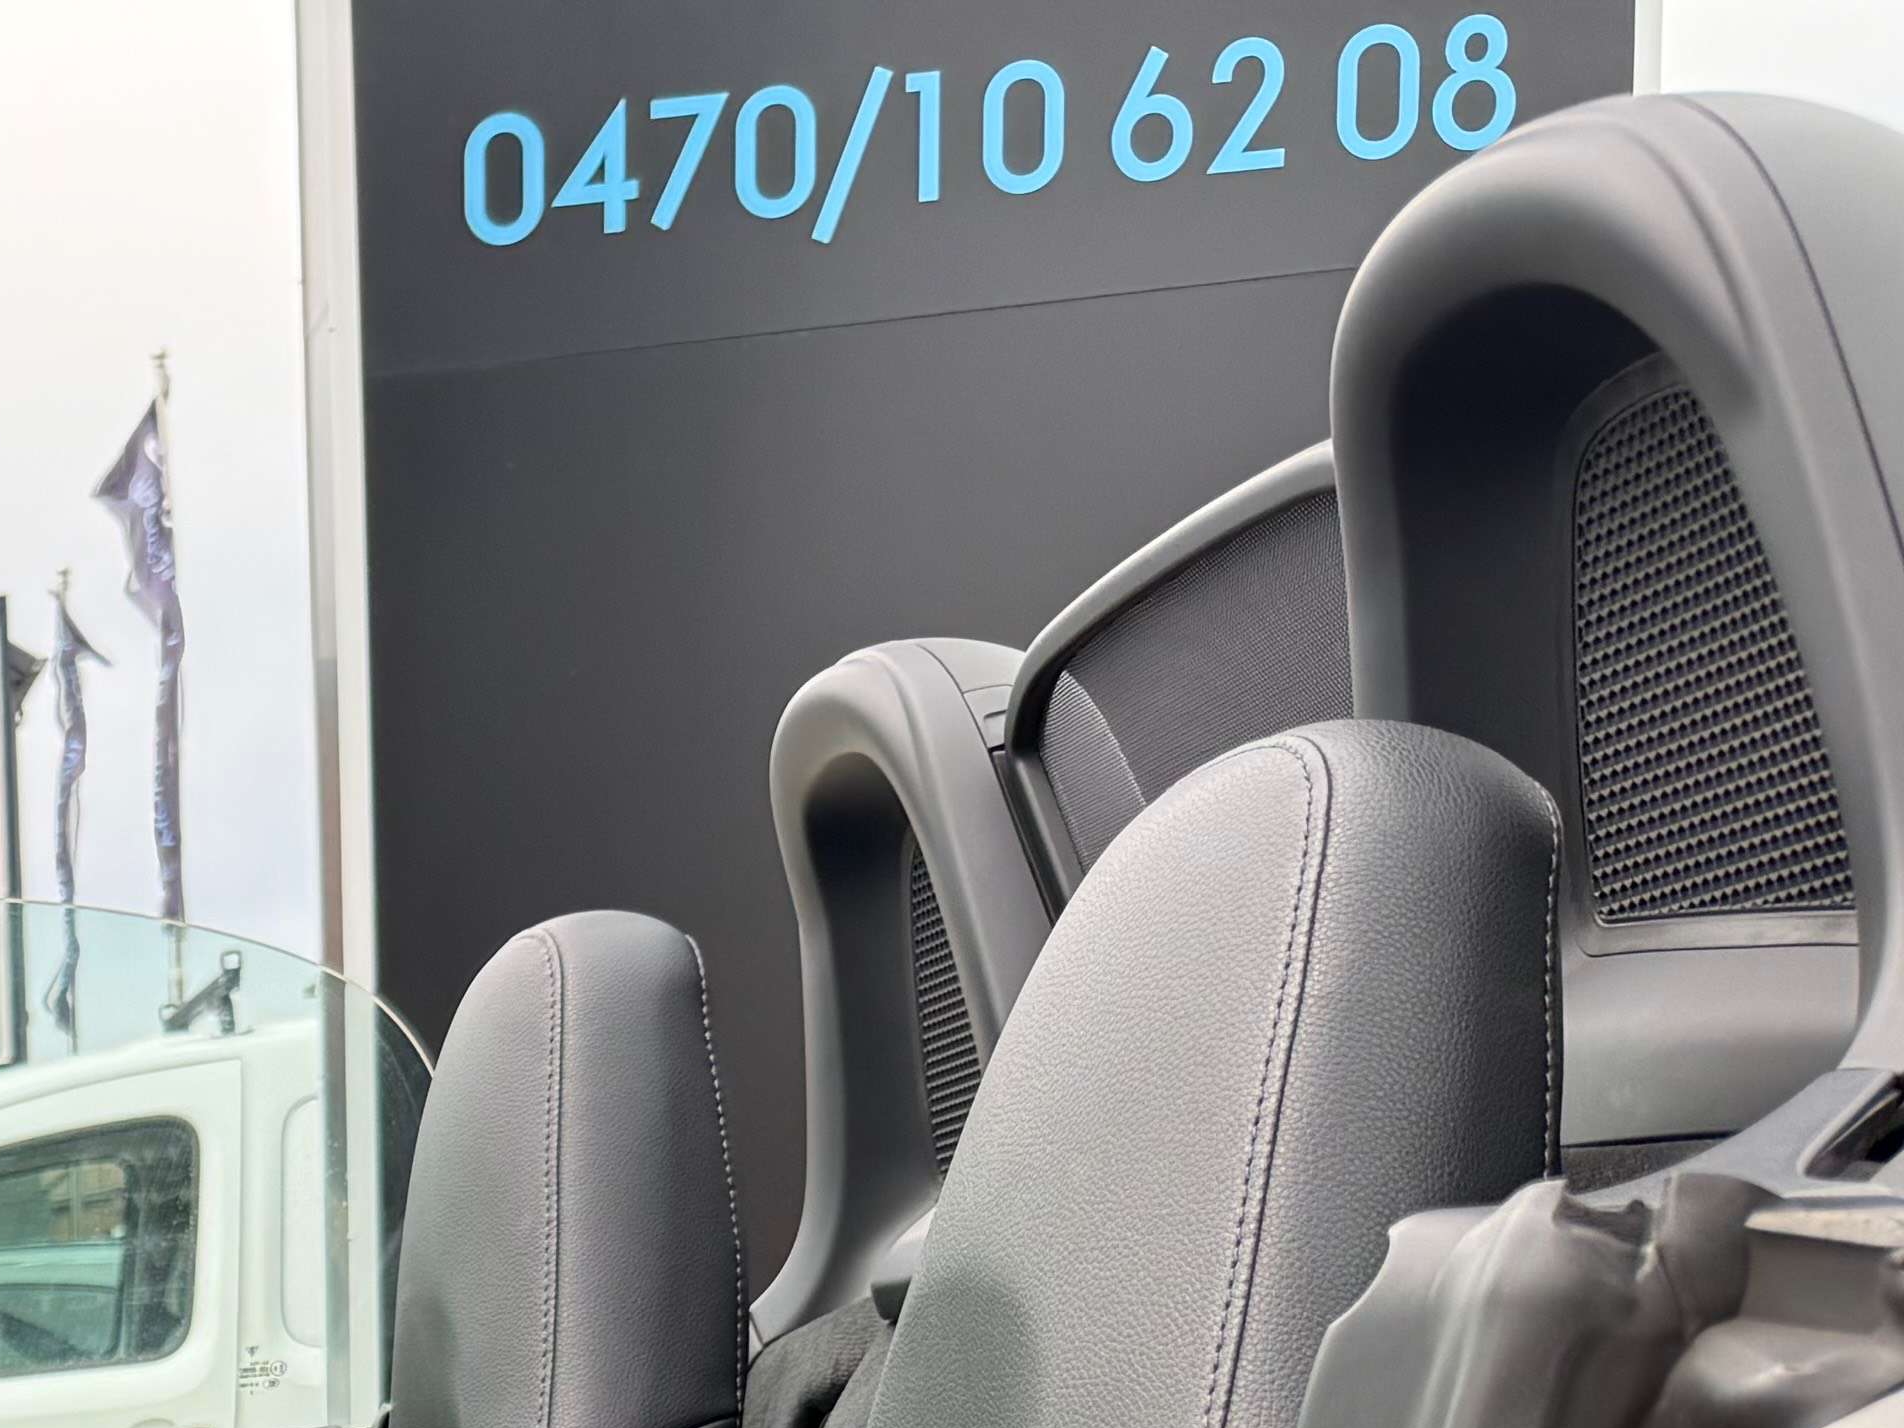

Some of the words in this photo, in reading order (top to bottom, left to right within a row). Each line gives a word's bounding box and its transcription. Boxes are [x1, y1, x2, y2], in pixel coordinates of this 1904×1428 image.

[463, 57, 1066, 248] 0470/10
[1110, 36, 1286, 184] 62
[1335, 13, 1518, 162] 08
